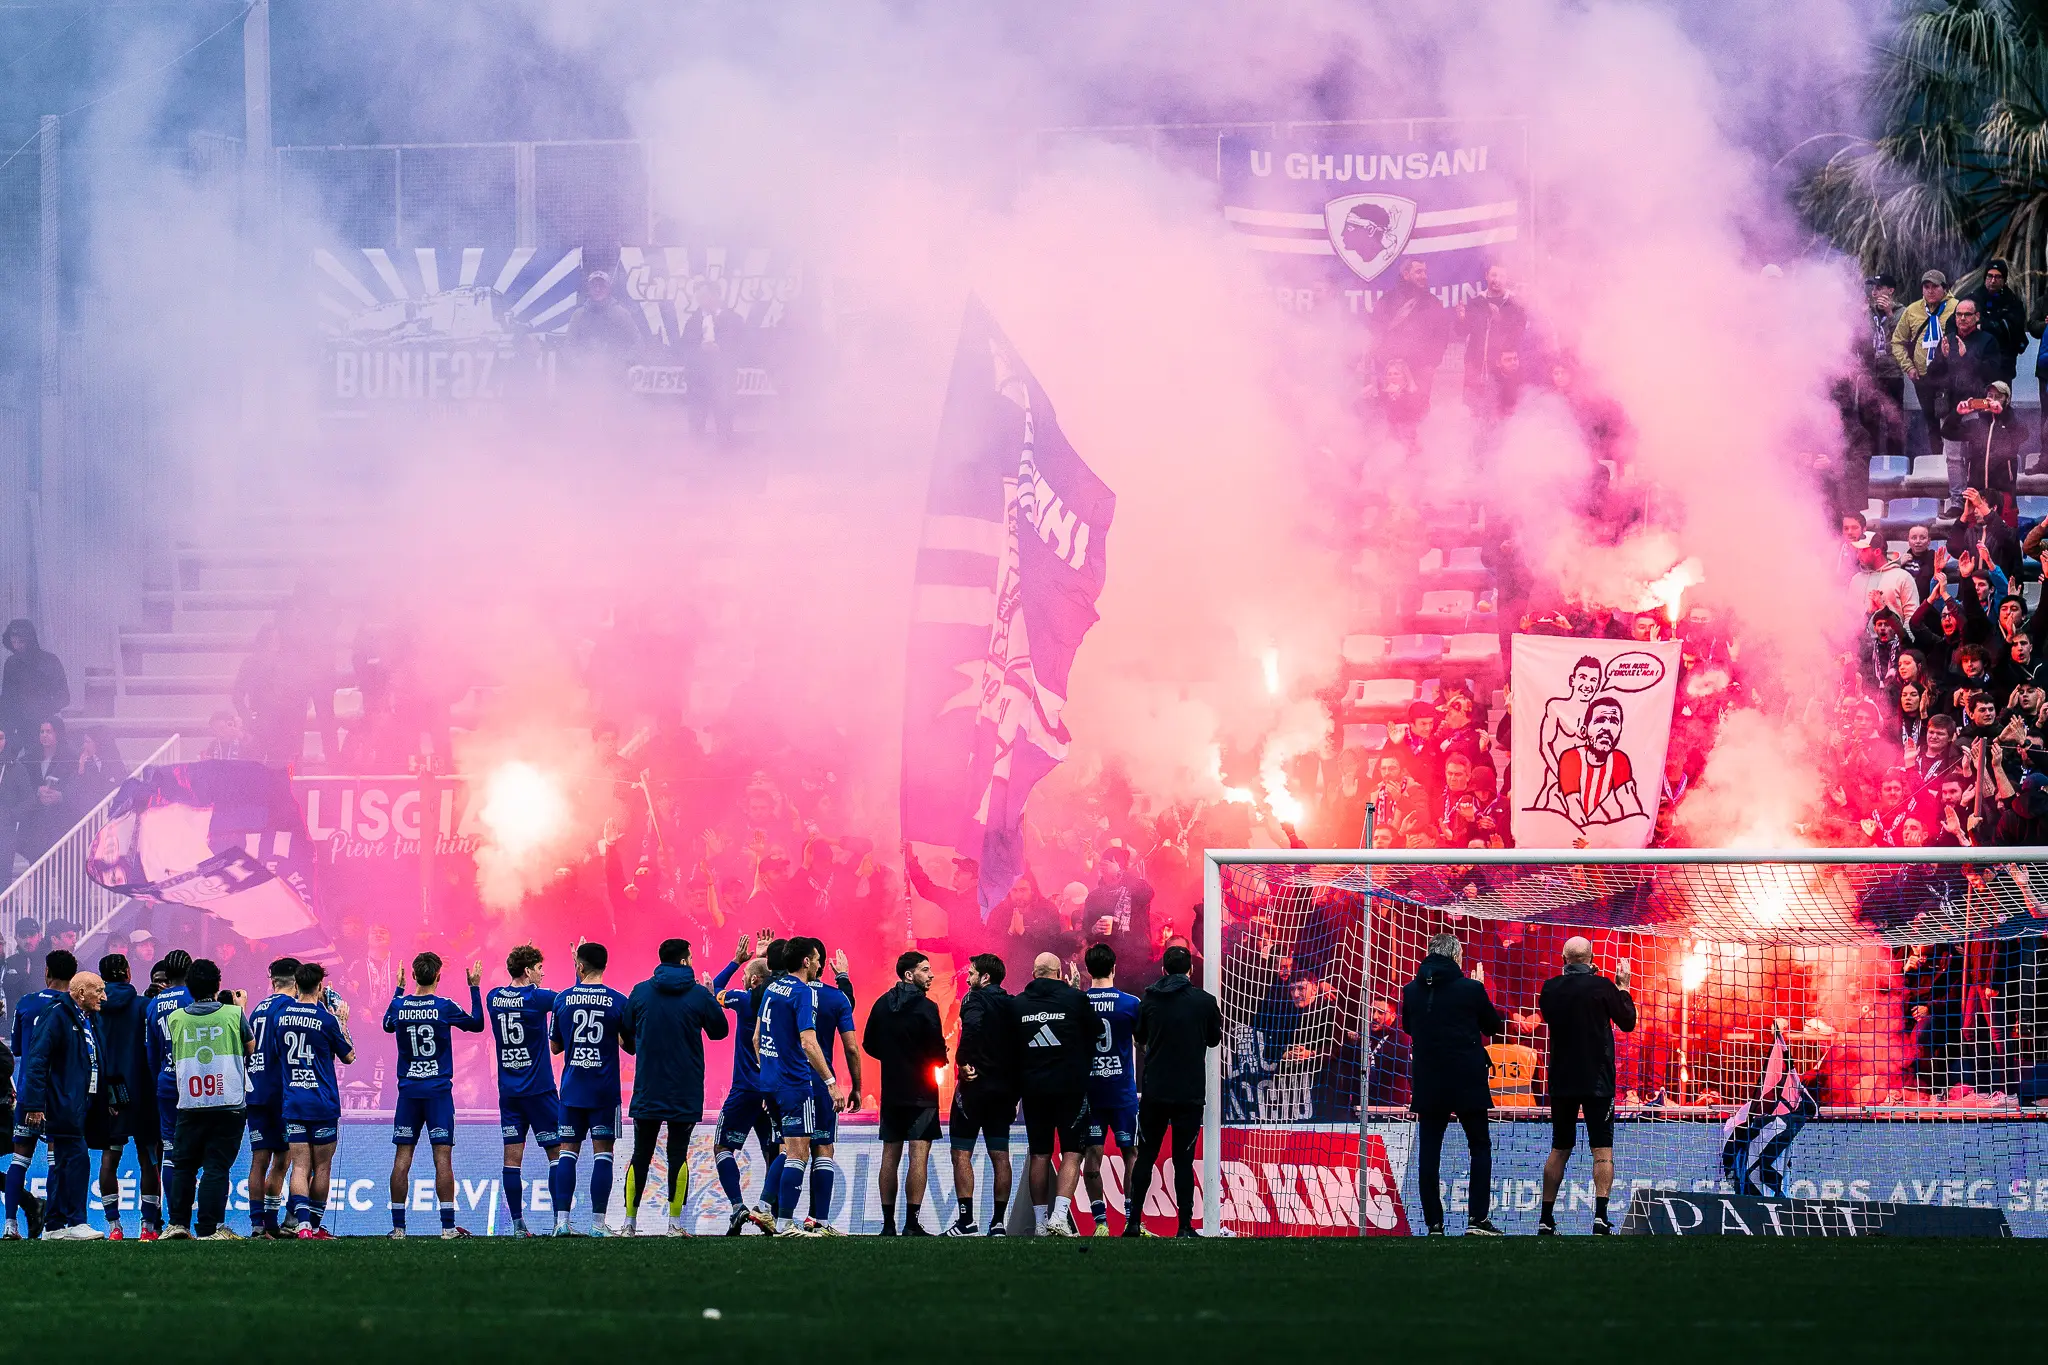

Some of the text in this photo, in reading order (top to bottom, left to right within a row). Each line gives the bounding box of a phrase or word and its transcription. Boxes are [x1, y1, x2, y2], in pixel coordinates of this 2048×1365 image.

[1250, 145, 1488, 181] U GHJUNSANI
[330, 831, 389, 864] Pieve
[157, 999, 178, 1013] ETOGA
[398, 1008, 439, 1021] DUCROCQ
[492, 997, 524, 1008] BOHNERT
[565, 994, 613, 1008] RODRIGUES
[761, 996, 772, 1032] 4
[183, 1026, 224, 1043] LFP
[278, 1015, 322, 1031] MEYNADIER
[497, 1012, 524, 1045] 15
[573, 1009, 605, 1044] 25
[284, 1031, 315, 1066] 24
[406, 1024, 436, 1057] 13
[188, 1073, 224, 1097] 09 PHOTO
[1262, 1164, 1398, 1230] KING
[1887, 1178, 1993, 1210] AVEC
